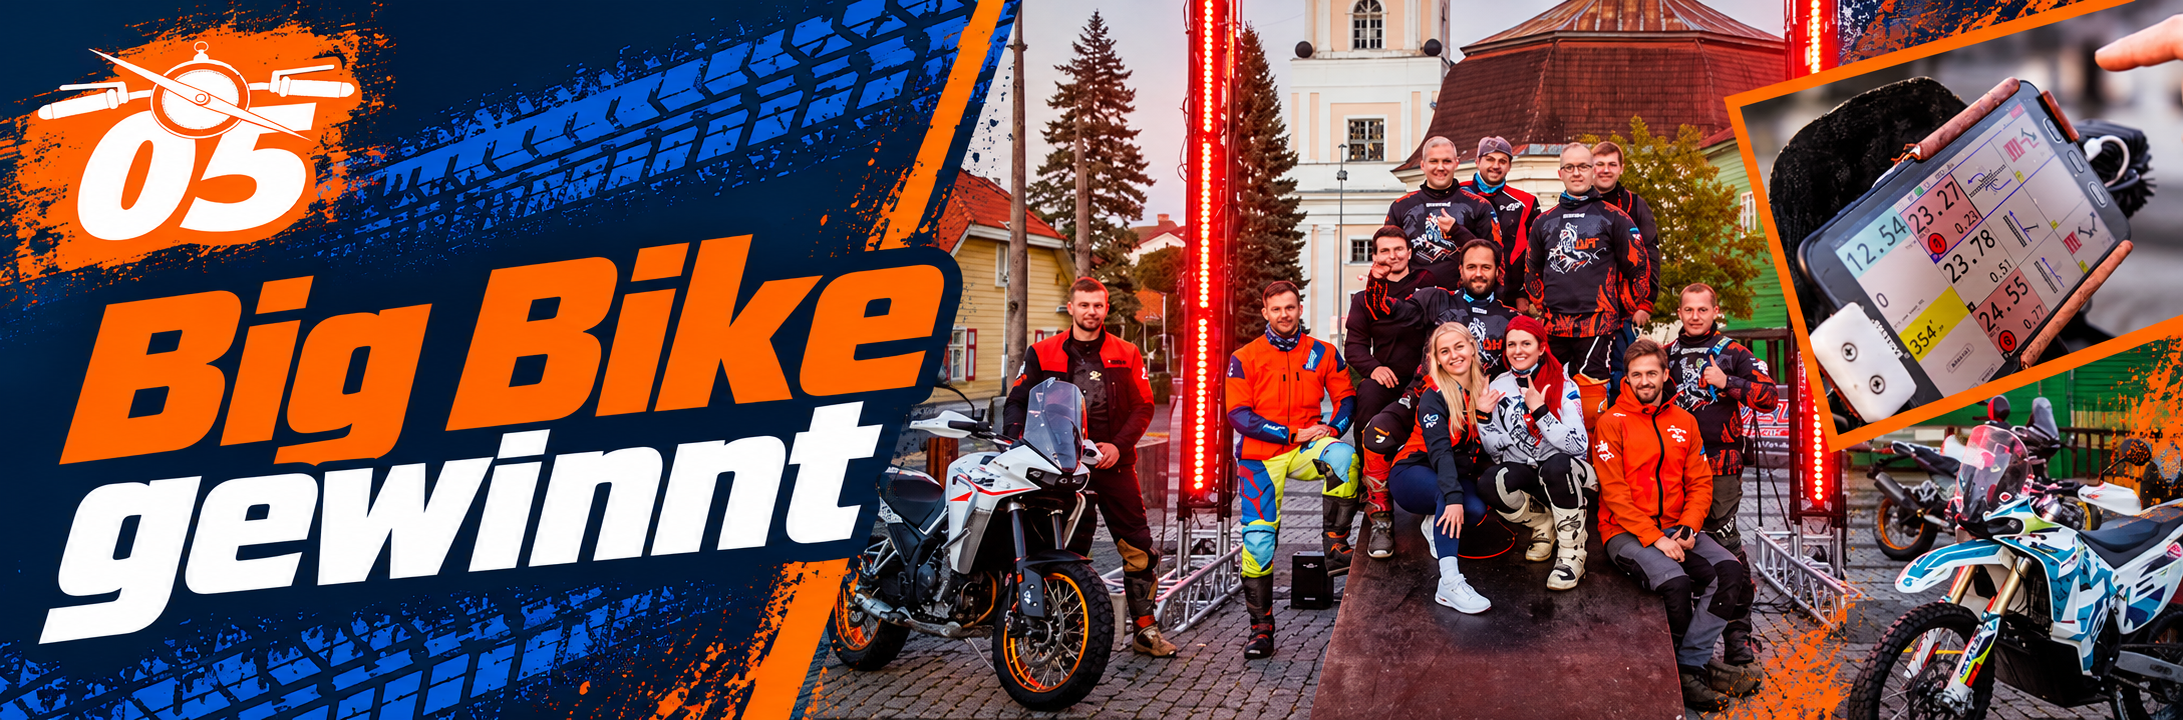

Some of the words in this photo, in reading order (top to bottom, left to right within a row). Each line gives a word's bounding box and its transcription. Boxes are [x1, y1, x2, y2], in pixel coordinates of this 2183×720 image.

[1908, 181, 1960, 235] 23.27
[1954, 210, 1979, 234] 0.23
[1846, 216, 1906, 271] 12.54
[1943, 229, 1995, 284] 23.78
[1989, 259, 2013, 283] 0.51
[1978, 276, 2028, 332] 24.55
[2023, 304, 2045, 330] 0.77
